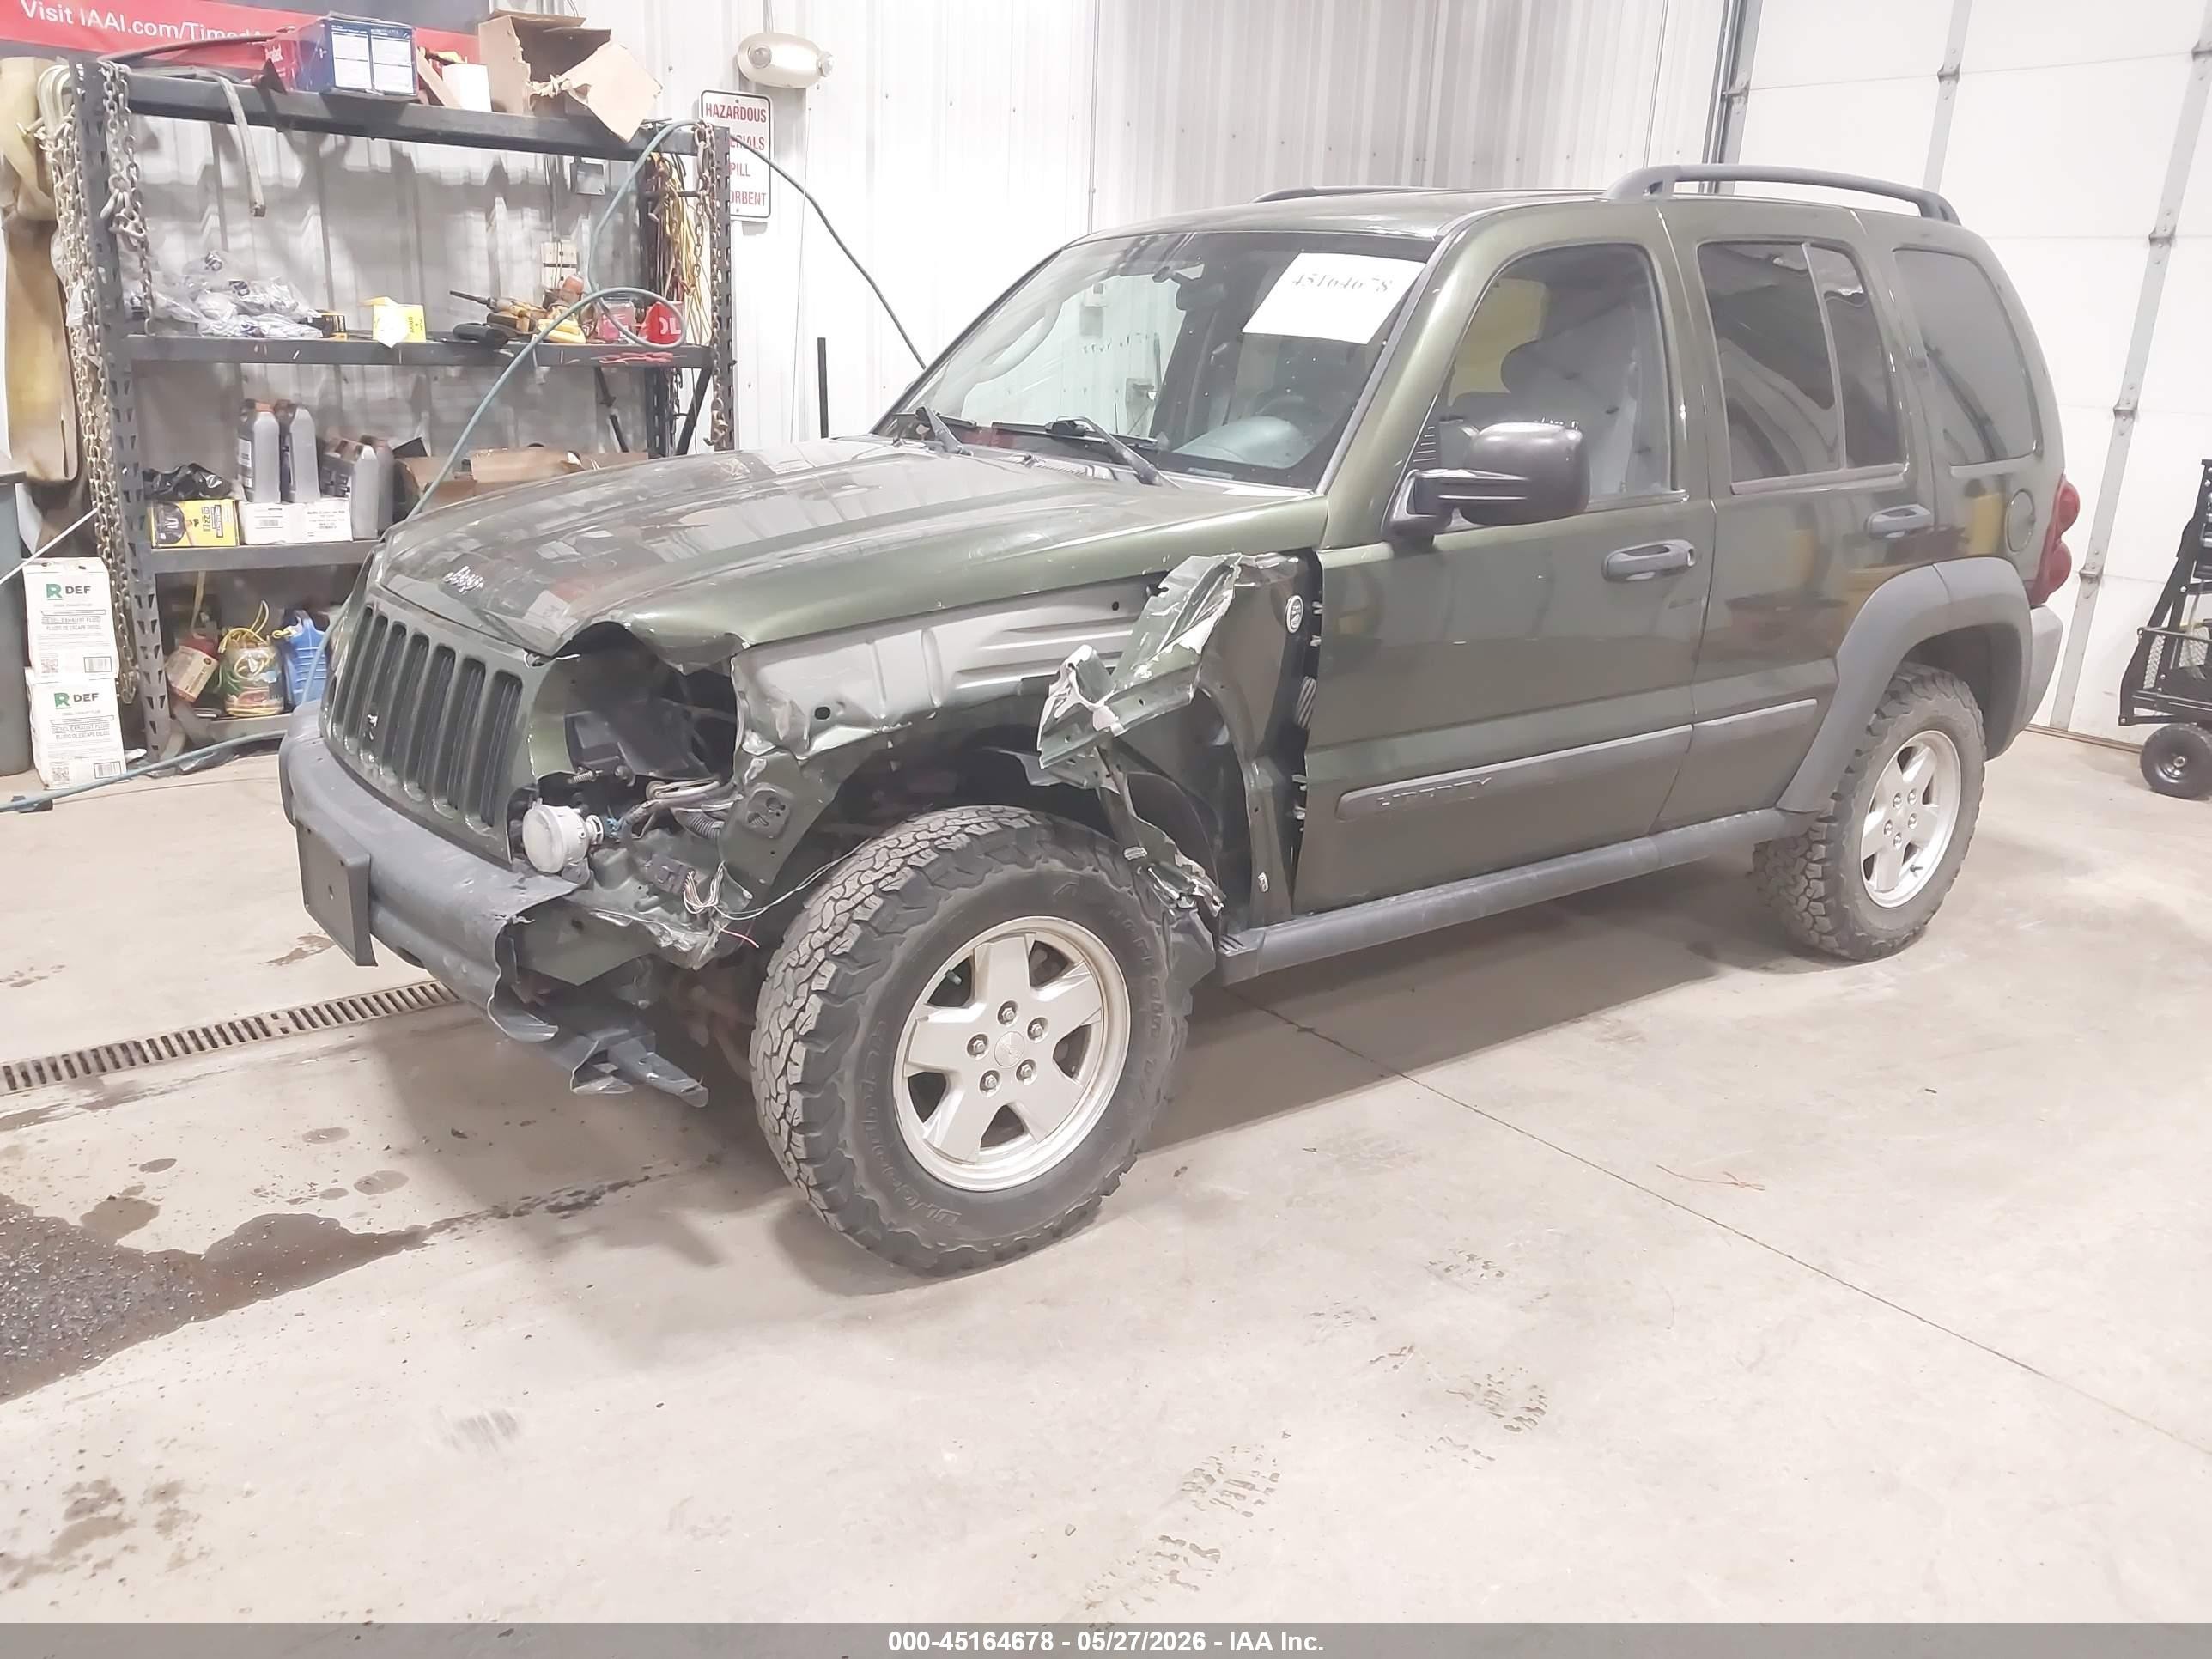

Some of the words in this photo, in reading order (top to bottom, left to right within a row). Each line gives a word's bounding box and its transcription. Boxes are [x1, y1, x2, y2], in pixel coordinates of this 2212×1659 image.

[20, 0, 74, 25] Visit
[705, 102, 767, 123] HAZARDOUS
[729, 134, 765, 151] ERIALS
[729, 163, 750, 177] PILL
[730, 190, 767, 207] ORBENT
[65, 586, 91, 594] DEF
[73, 693, 99, 702] DEF
